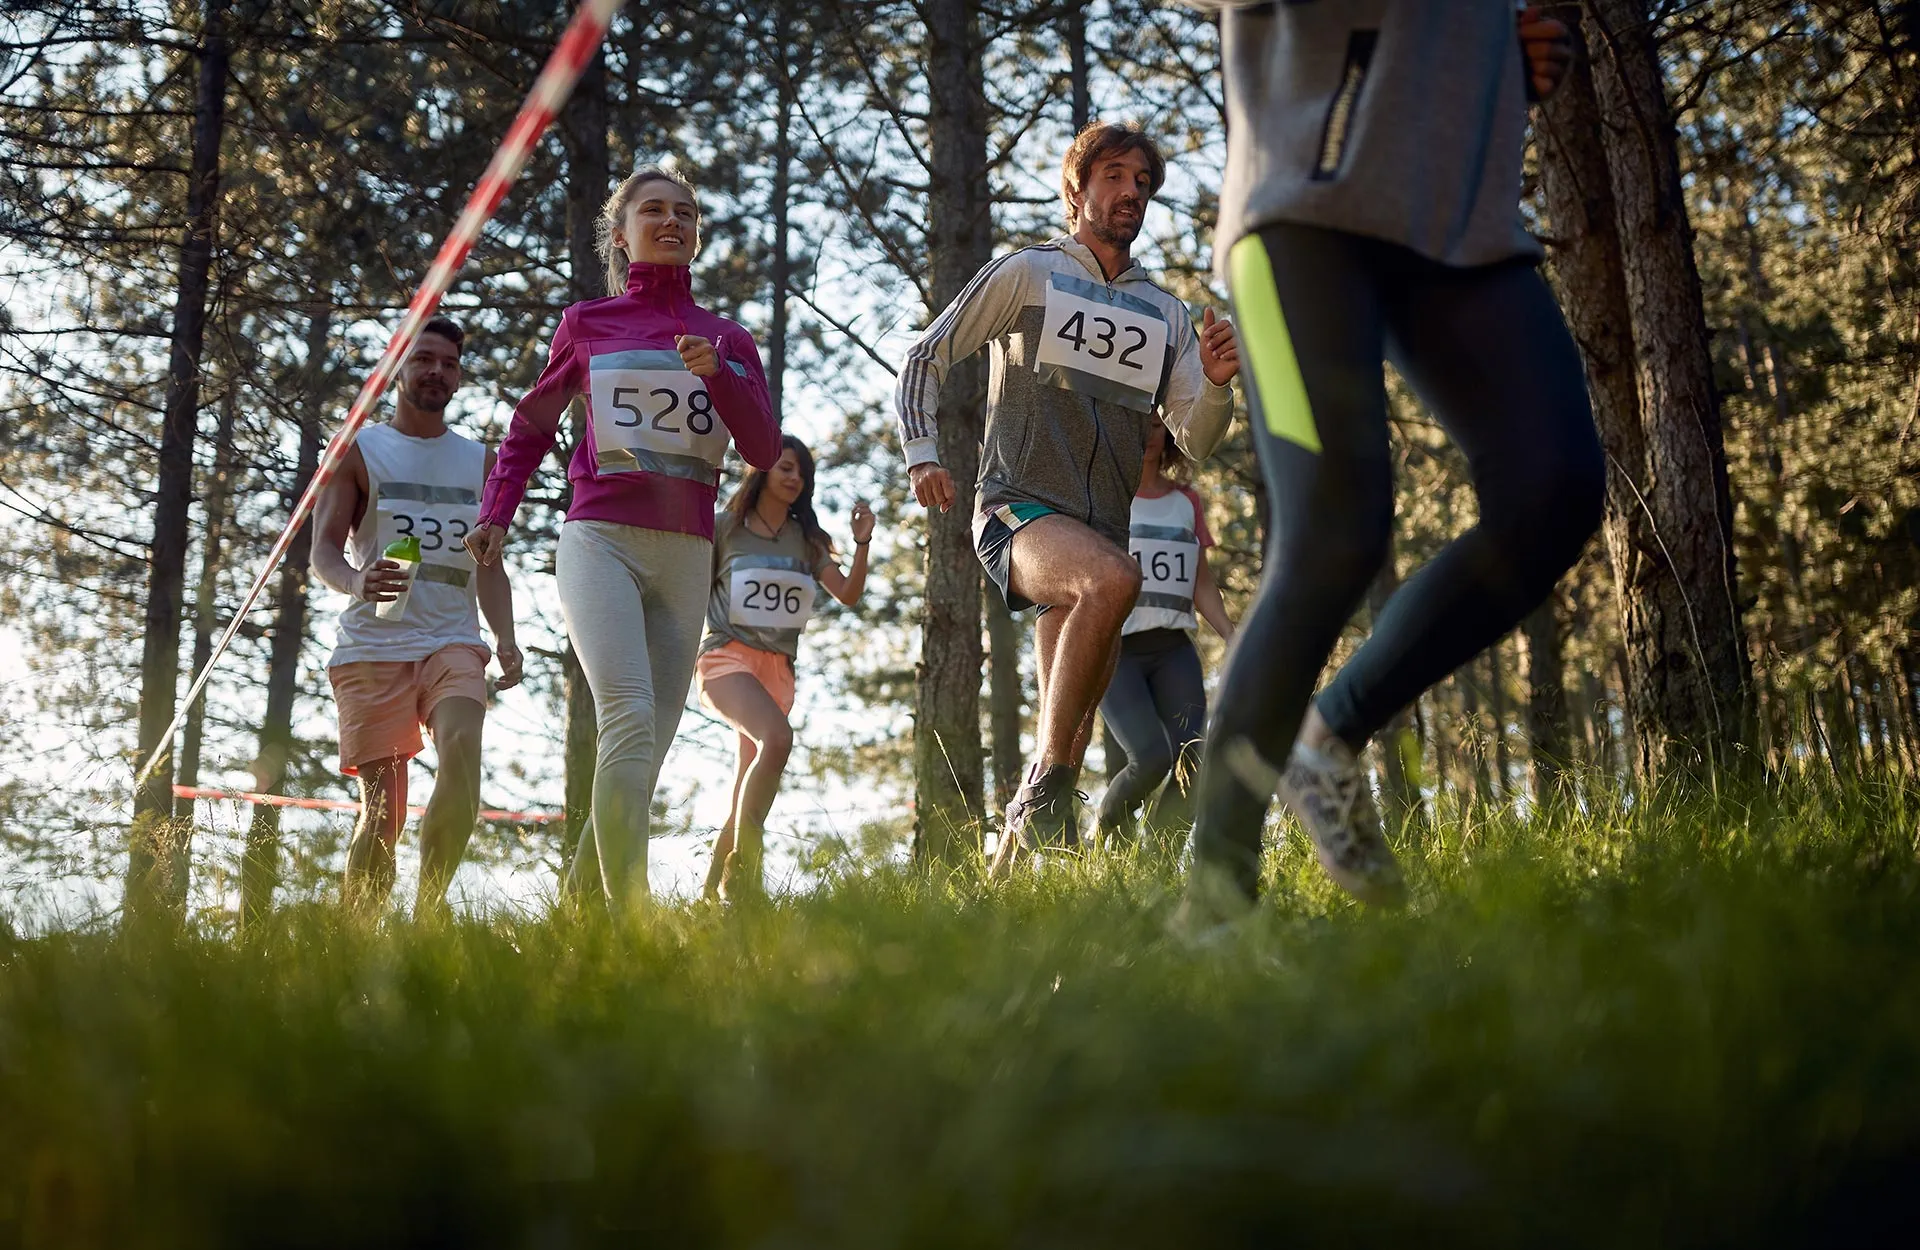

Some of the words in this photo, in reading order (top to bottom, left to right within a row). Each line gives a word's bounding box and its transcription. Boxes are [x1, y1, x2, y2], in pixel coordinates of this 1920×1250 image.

[1057, 310, 1148, 371] 432
[612, 387, 714, 436] 528
[742, 580, 802, 615] 296
